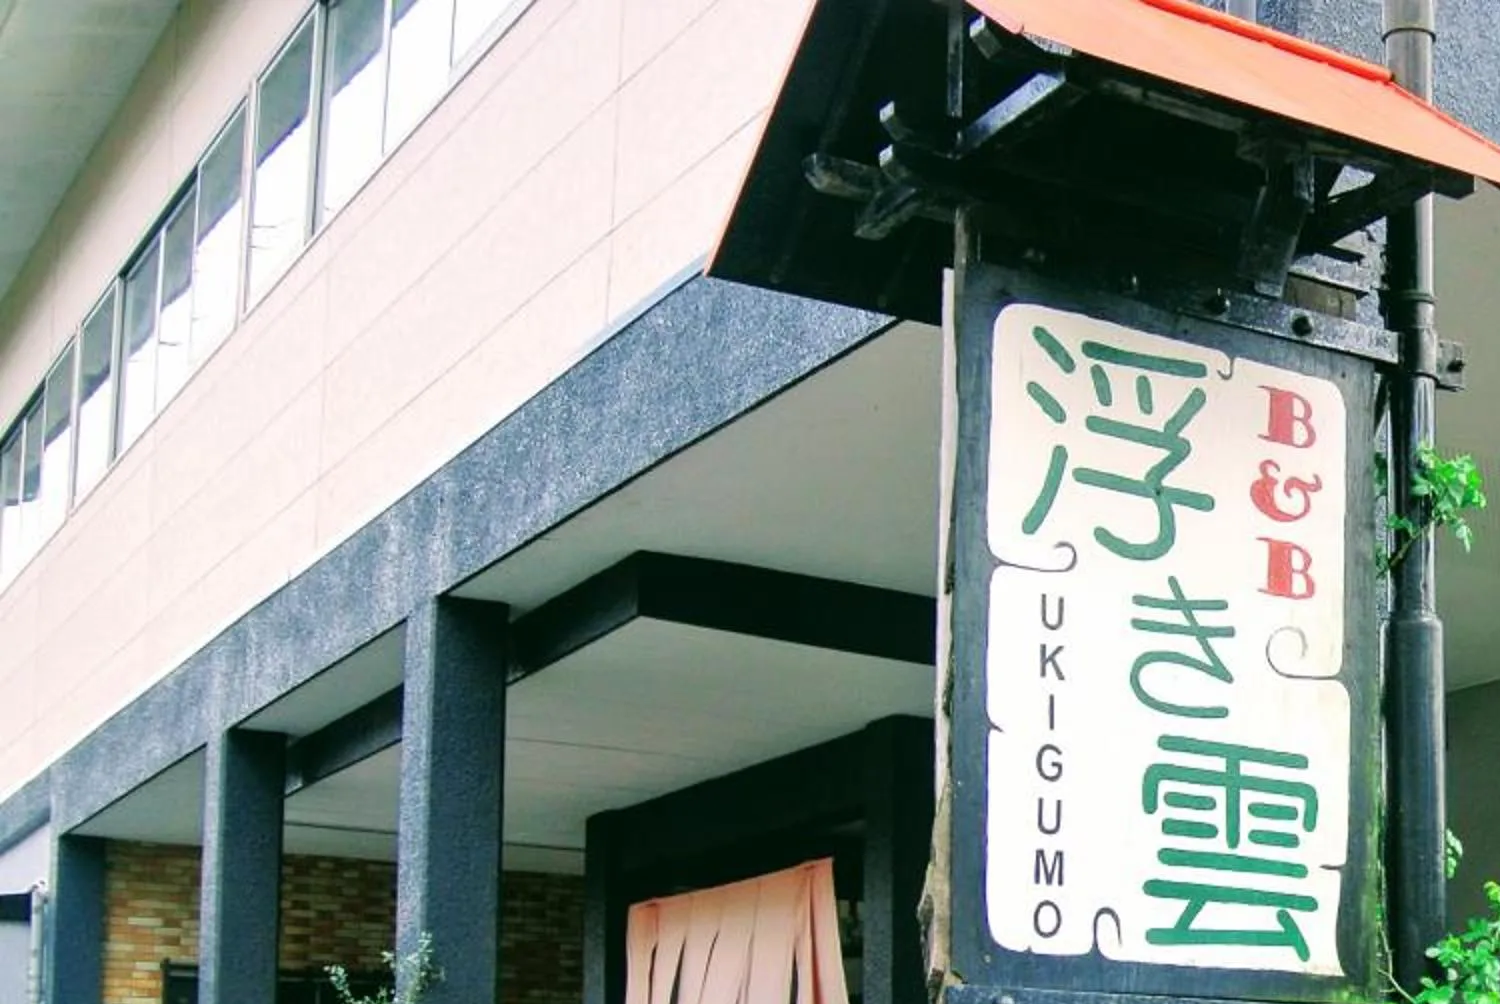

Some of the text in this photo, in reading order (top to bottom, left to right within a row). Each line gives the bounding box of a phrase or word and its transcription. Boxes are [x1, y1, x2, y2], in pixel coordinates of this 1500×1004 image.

[1021, 326, 1319, 962] 浮き雲
[1249, 385, 1322, 600] B&B
[1033, 593, 1065, 939] UKIGUMO
